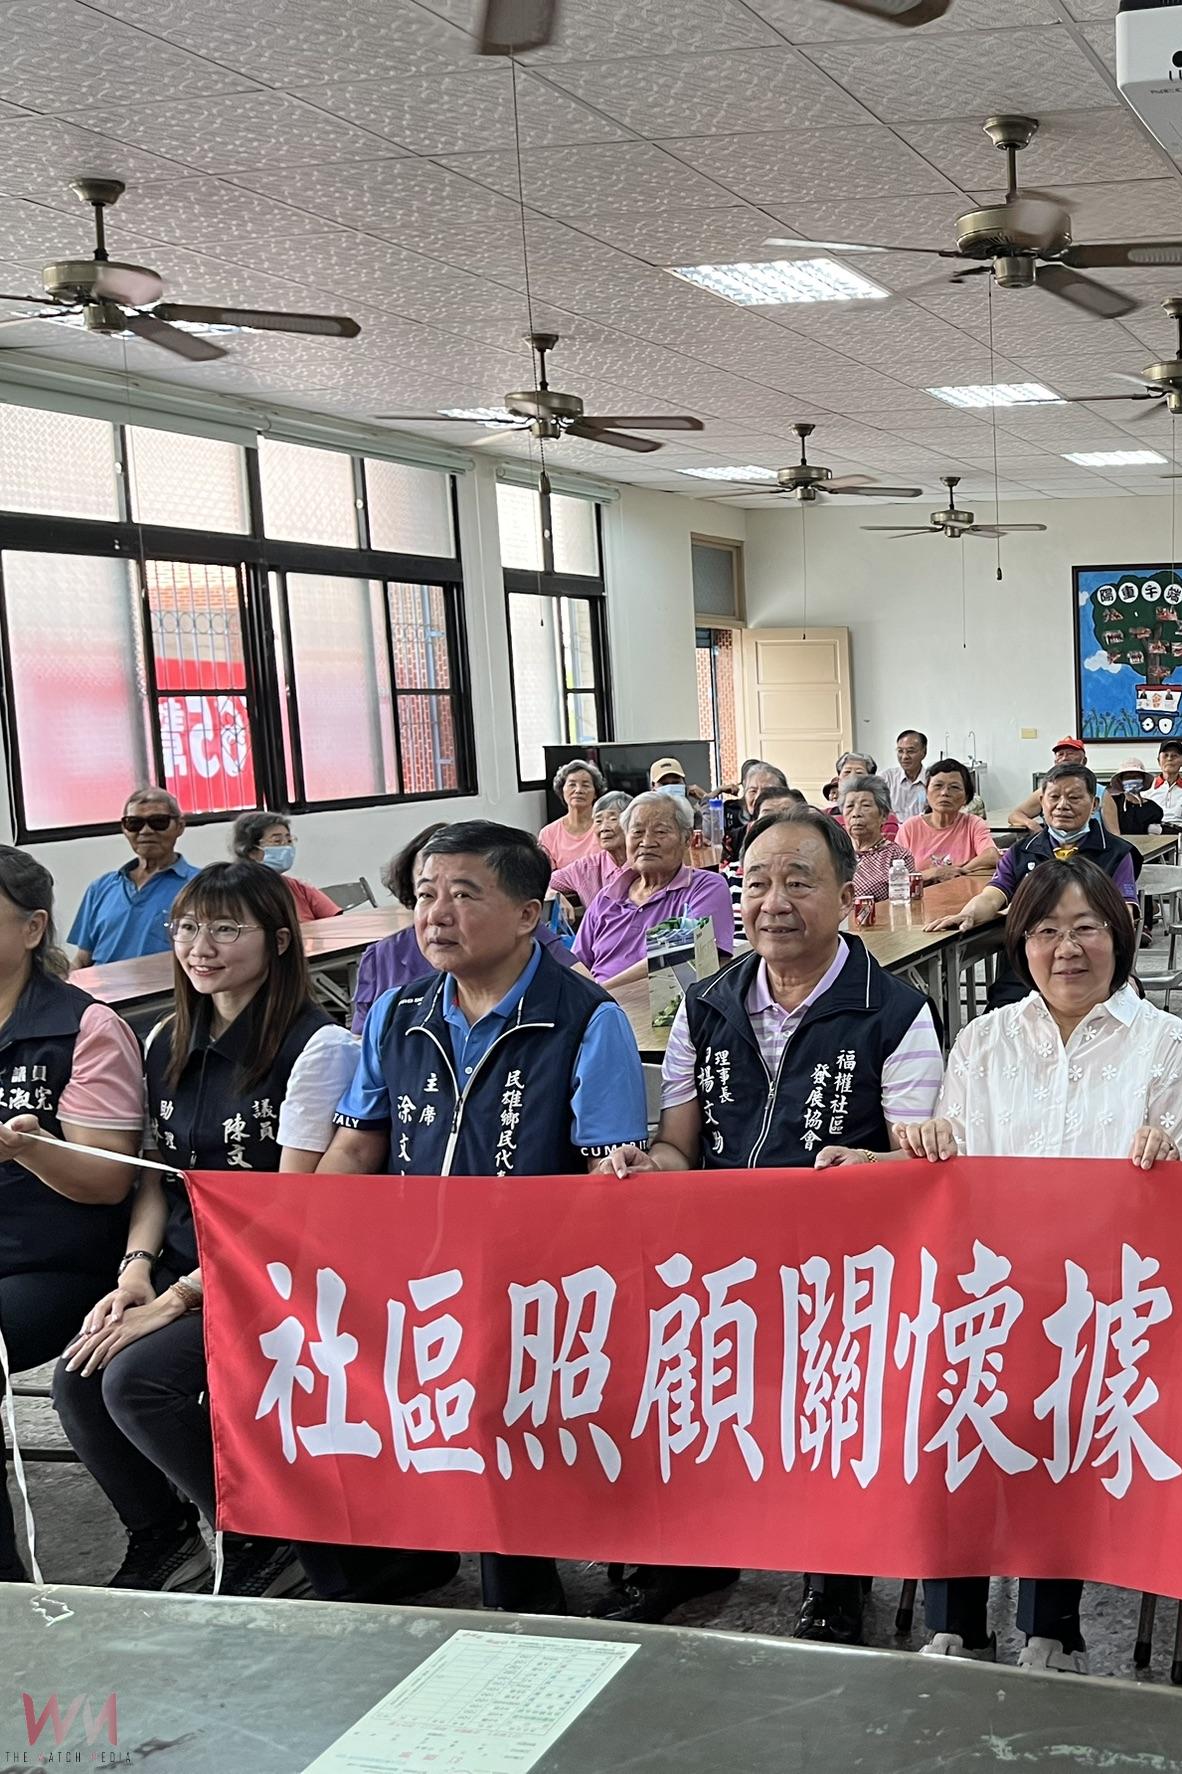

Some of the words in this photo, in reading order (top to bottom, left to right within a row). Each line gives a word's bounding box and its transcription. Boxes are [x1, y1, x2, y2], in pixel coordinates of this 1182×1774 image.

[0, 1065, 47, 1083] 議員
[418, 1073, 439, 1127] 主席
[714, 1050, 735, 1104] 理事長
[829, 1049, 857, 1135] 福權社區
[252, 1098, 278, 1141] 議員
[800, 1063, 832, 1152] 發展協會
[397, 1094, 416, 1177] 涂文
